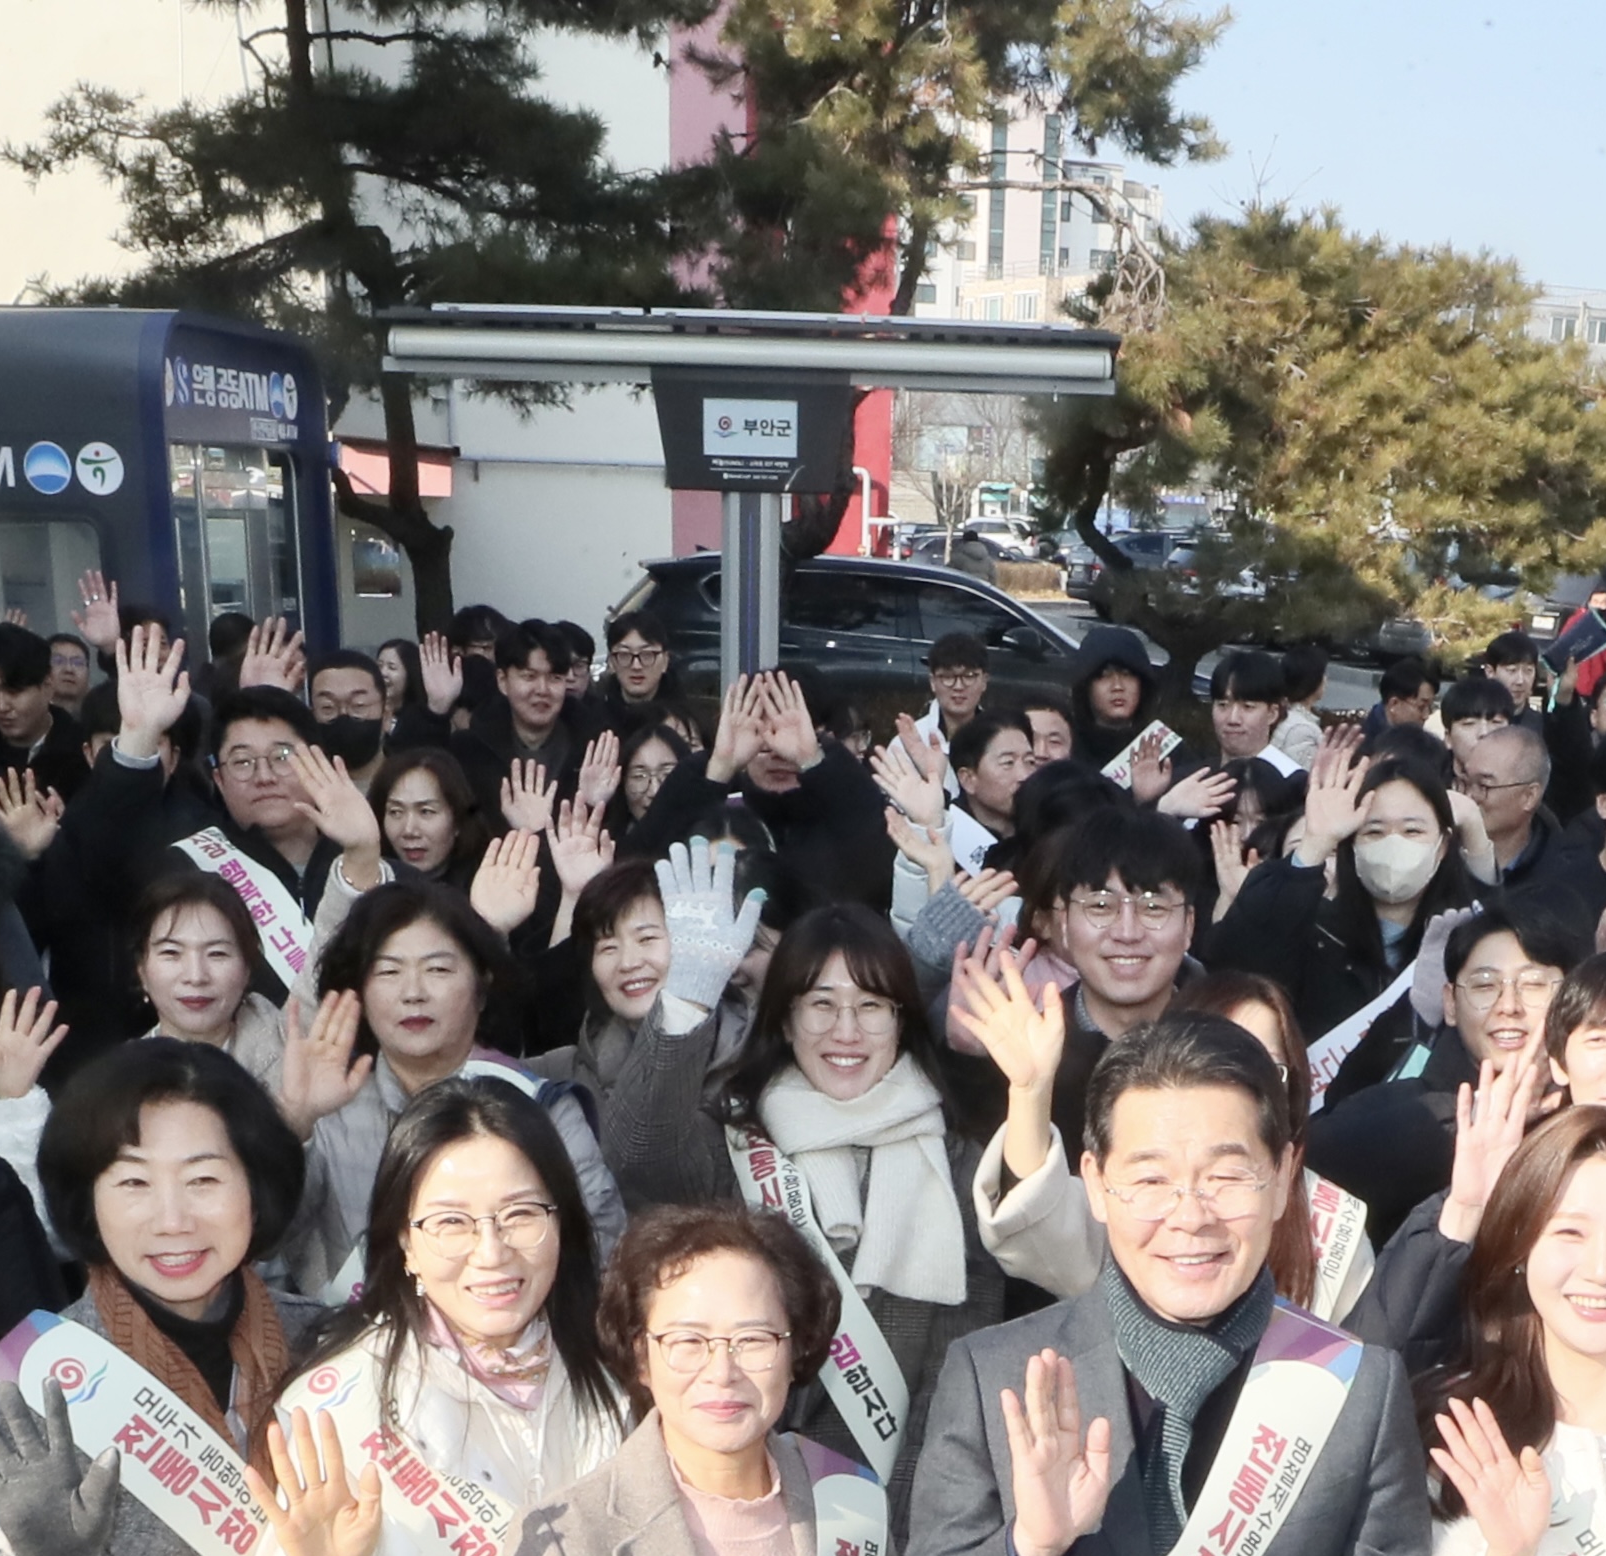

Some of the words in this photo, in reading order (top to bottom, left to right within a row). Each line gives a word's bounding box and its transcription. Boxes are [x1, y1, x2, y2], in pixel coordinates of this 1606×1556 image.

[743, 418, 792, 437] 부안군
[133, 1387, 202, 1449] 모두가
[113, 1414, 259, 1555] 전통시장
